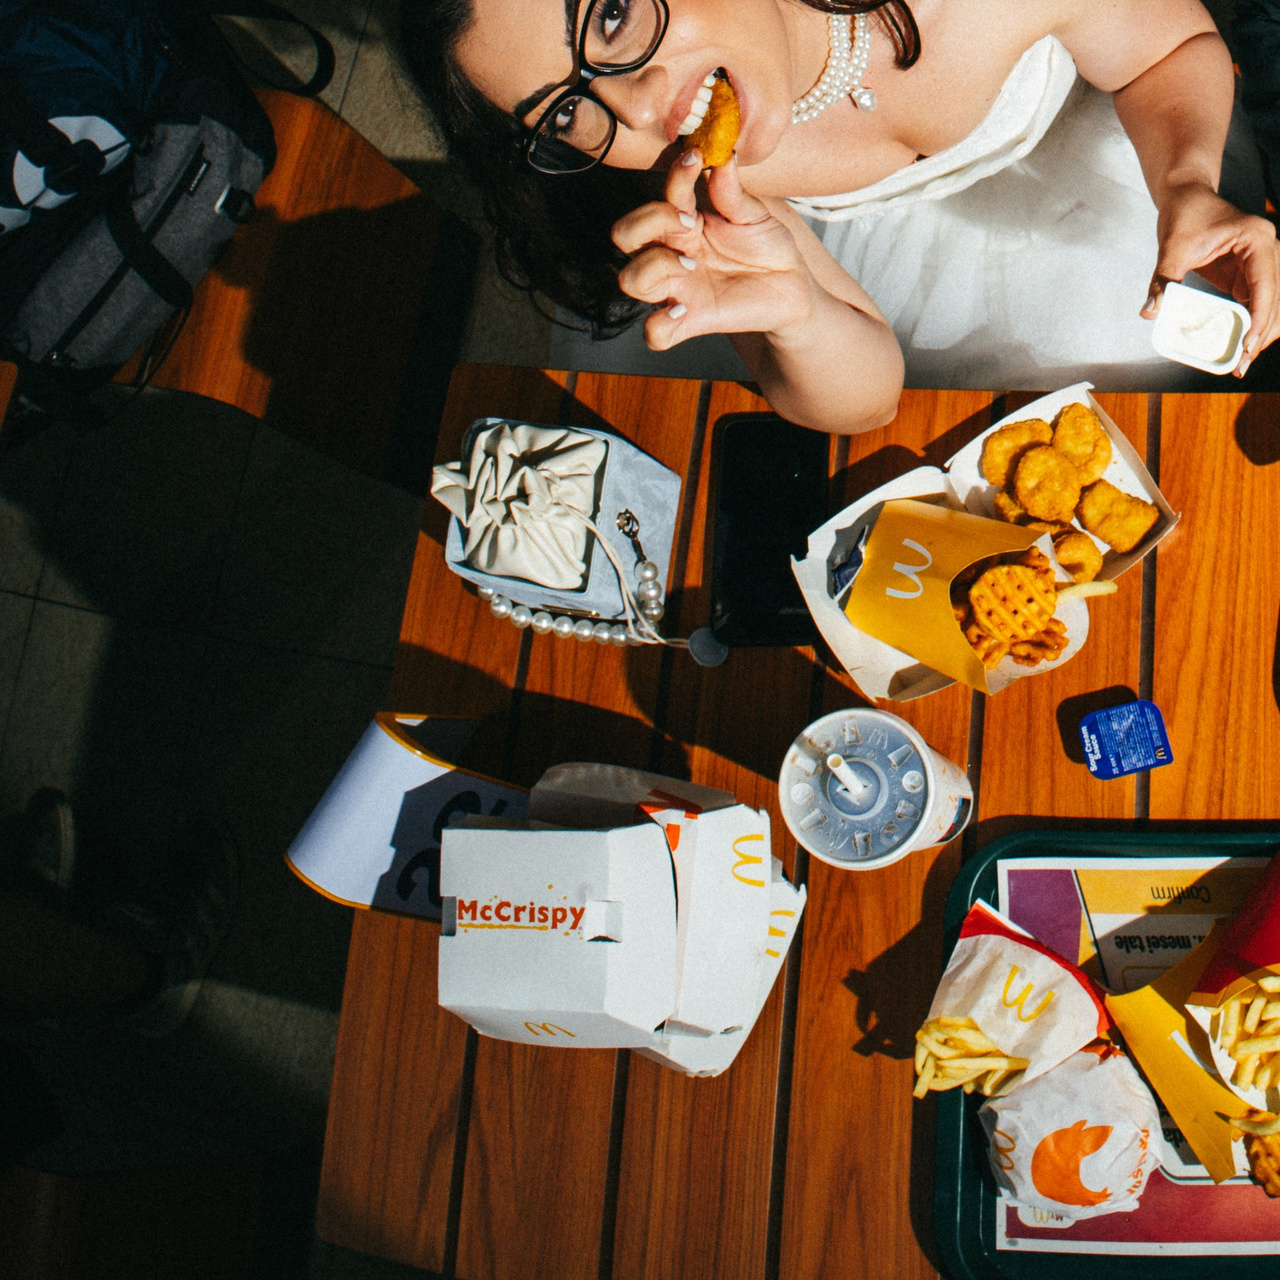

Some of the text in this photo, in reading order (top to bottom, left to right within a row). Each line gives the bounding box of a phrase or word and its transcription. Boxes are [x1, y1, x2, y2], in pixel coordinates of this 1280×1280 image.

[1081, 726, 1098, 772] Sour Cream
[1090, 734, 1101, 760] Sauce
[1150, 886, 1211, 905] Confirm
[458, 899, 586, 930] McCrispy
[1114, 935, 1145, 954] tale
[1146, 935, 1192, 954] mesei
